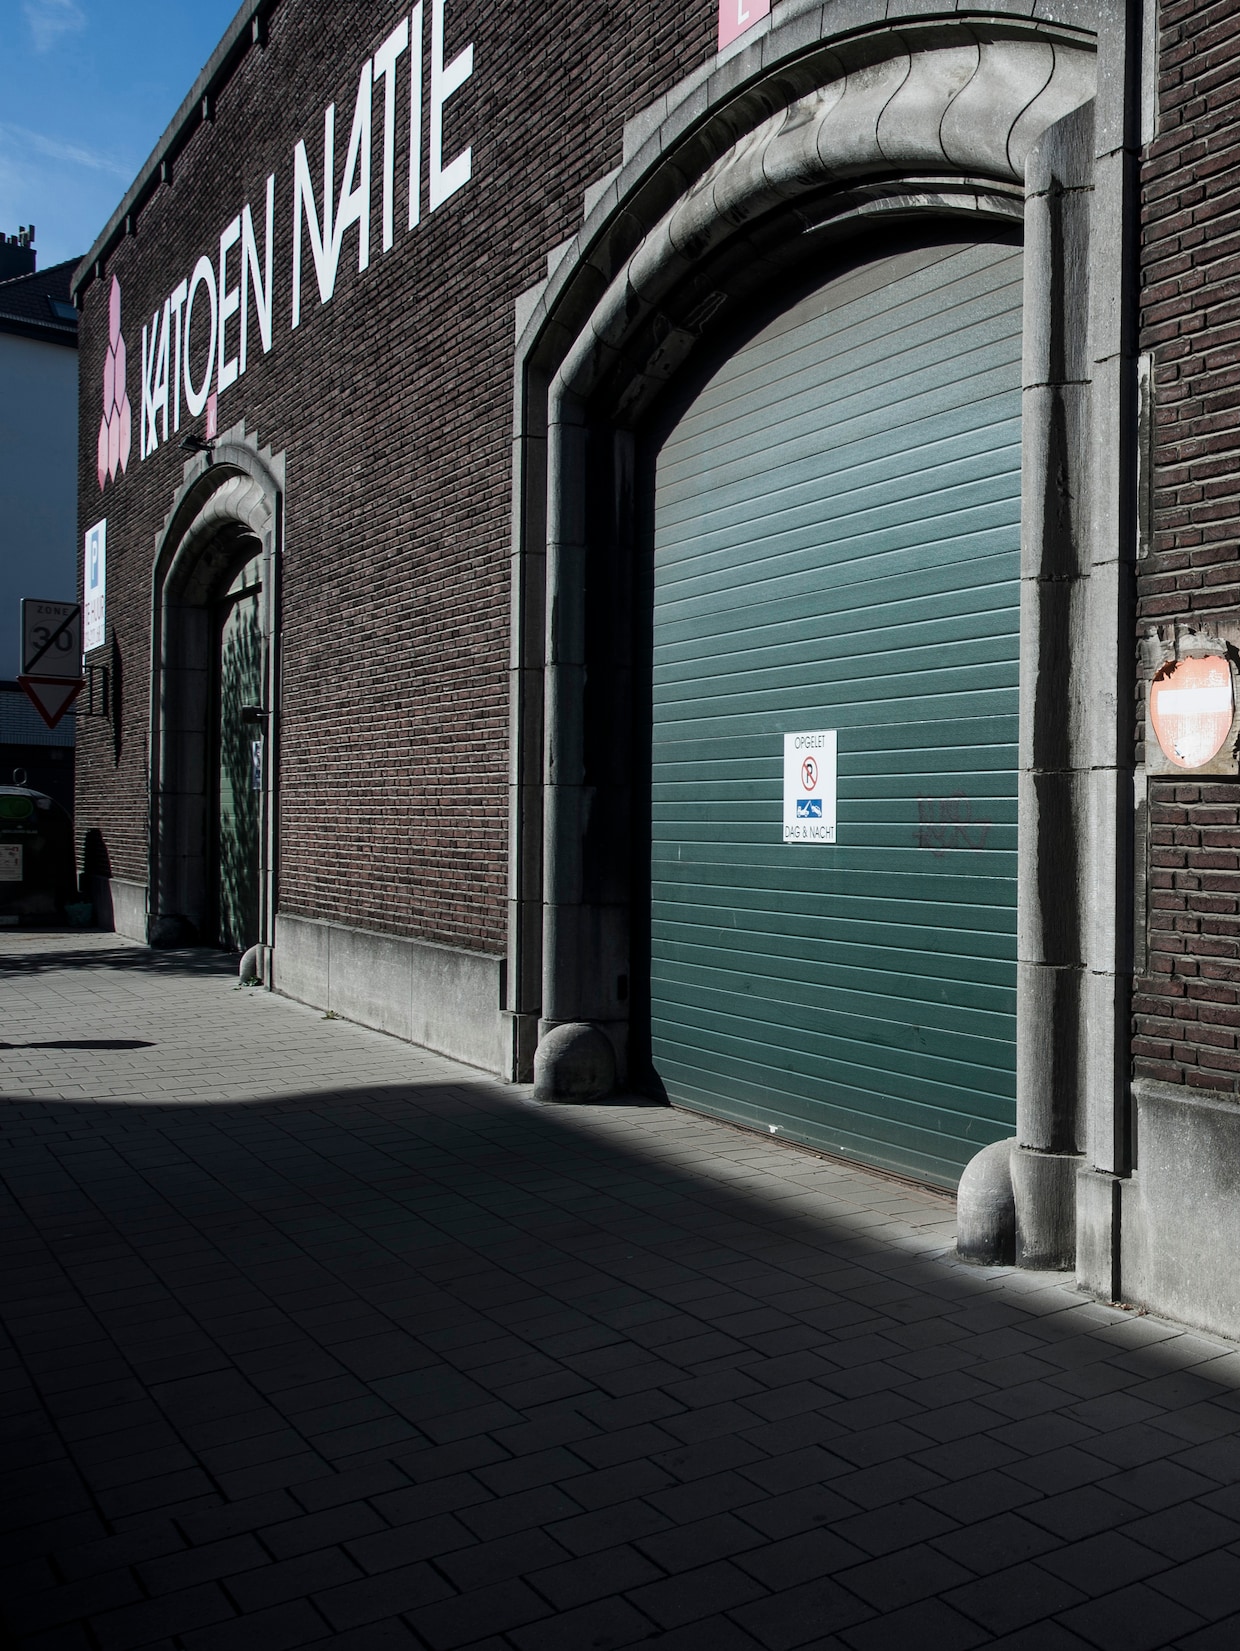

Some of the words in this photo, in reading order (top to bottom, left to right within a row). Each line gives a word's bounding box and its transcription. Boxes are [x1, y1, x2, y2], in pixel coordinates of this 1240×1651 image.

[140, 173, 275, 462] KATOEN
[291, 0, 475, 331] NATIE
[91, 539, 98, 580] P
[36, 605, 70, 617] ZONE
[32, 626, 73, 652] 30
[794, 735, 826, 750] OPGELET
[785, 825, 801, 839] DAG
[802, 825, 808, 839] &
[809, 825, 835, 840] NACHT
